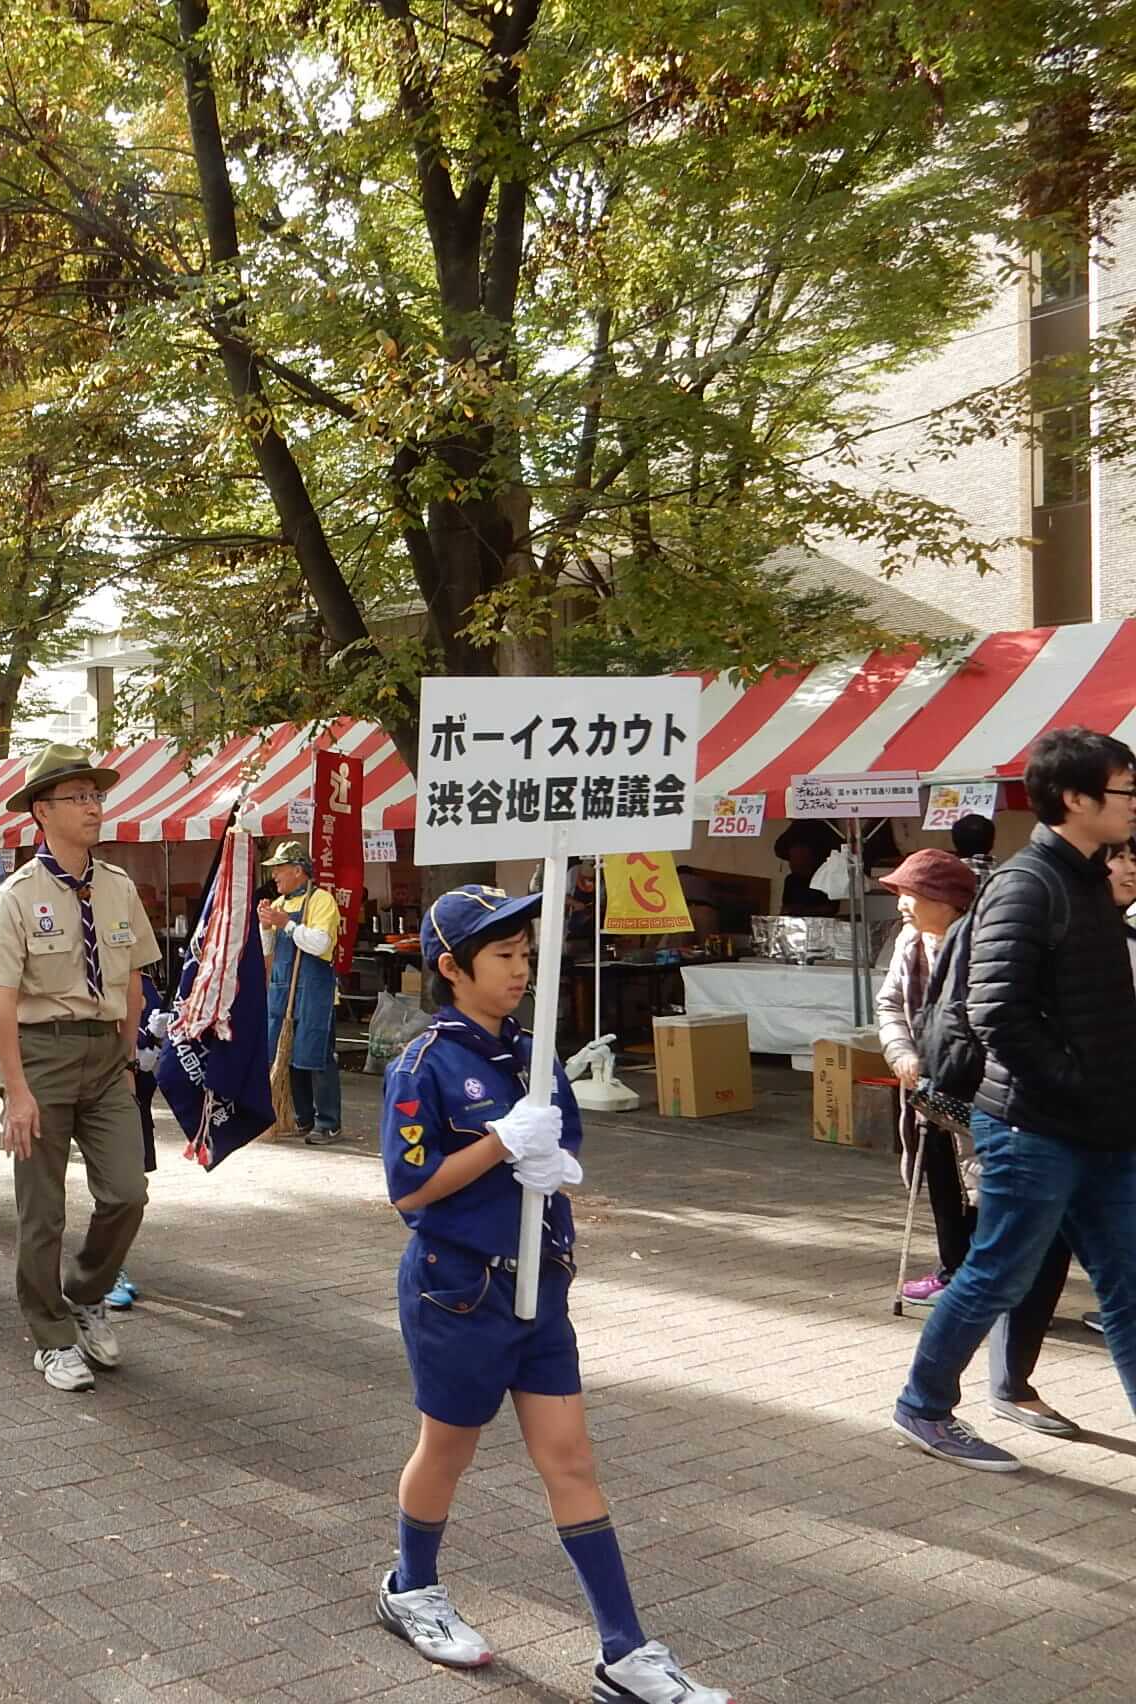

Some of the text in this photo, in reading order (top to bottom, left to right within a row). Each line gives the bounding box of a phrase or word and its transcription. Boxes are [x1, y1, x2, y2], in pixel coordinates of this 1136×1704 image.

[429, 712, 688, 762] ボーイスカウト
[426, 773, 687, 828] 渋谷地区協議会
[712, 816, 757, 834] 250円
